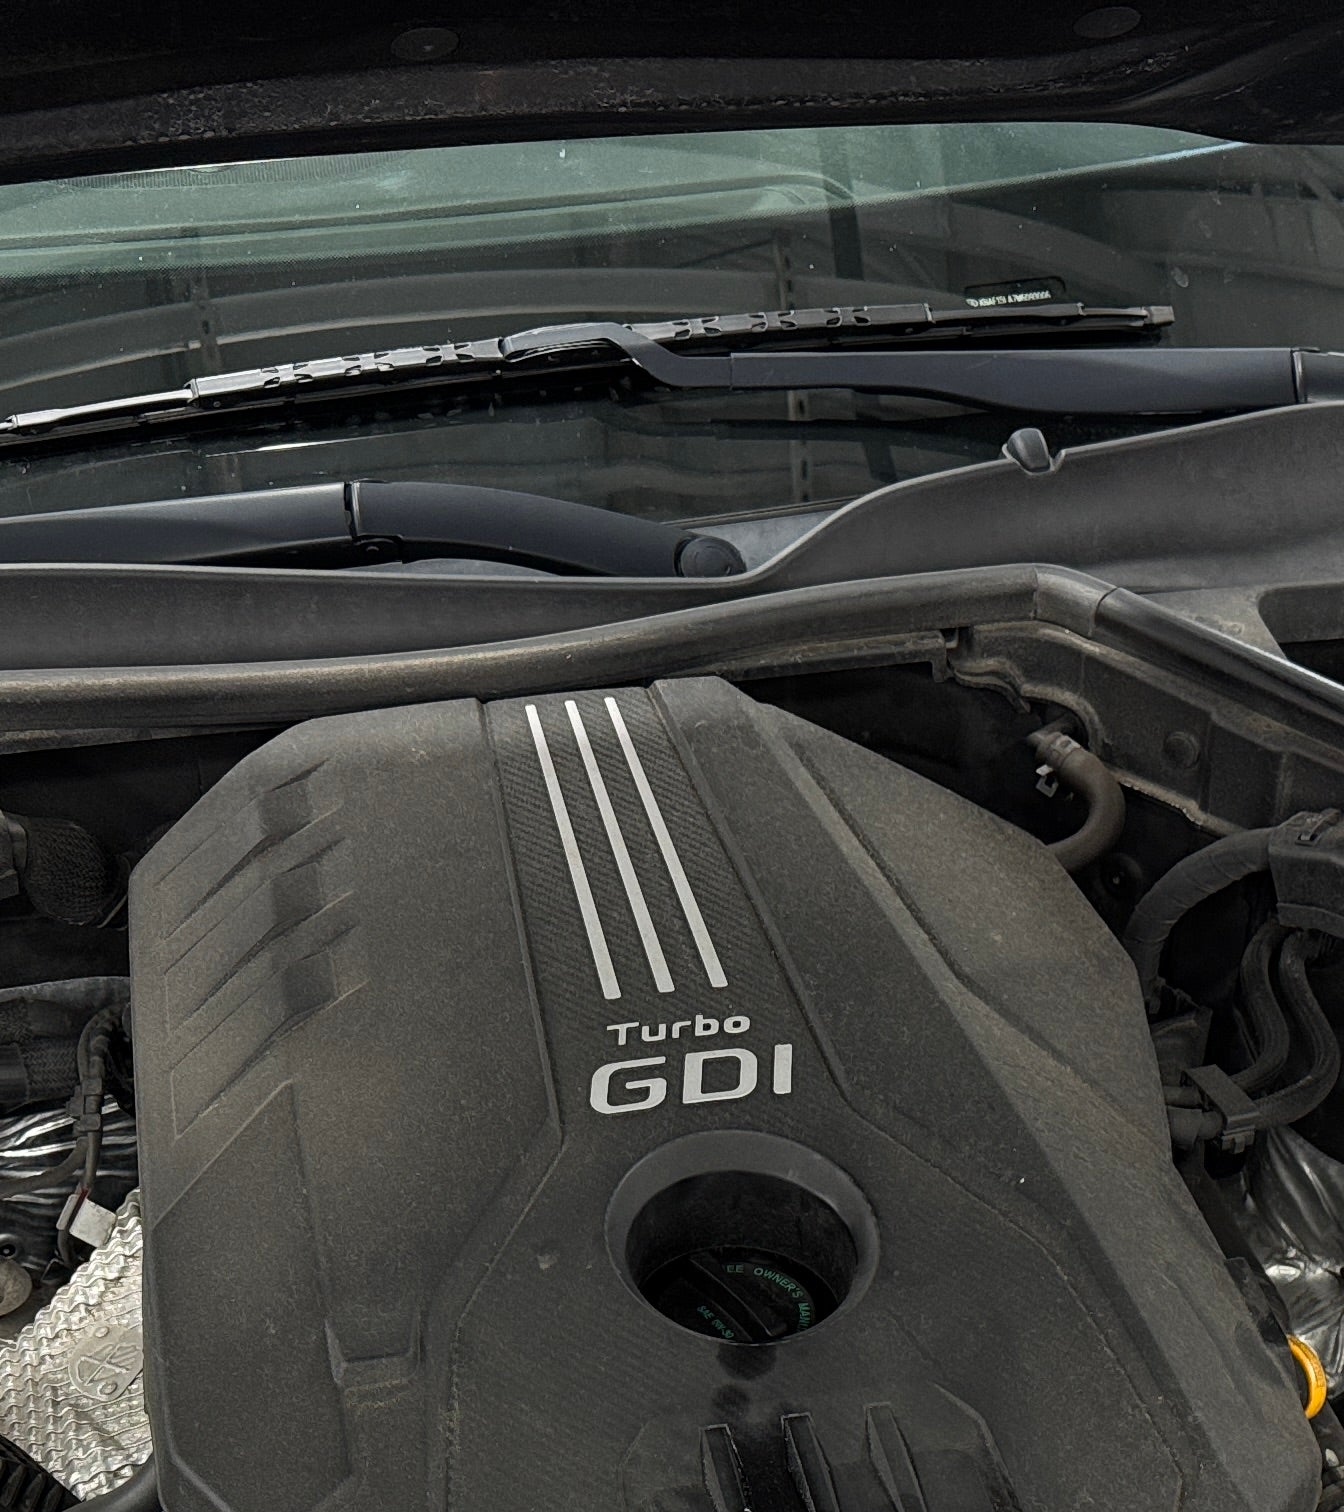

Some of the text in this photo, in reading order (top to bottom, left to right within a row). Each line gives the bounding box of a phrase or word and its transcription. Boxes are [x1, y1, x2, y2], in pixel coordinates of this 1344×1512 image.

[606, 1014, 751, 1046] Turbo
[590, 1043, 793, 1115] GDI
[722, 1264, 745, 1274] EE
[753, 1267, 804, 1298] OWNER'S
